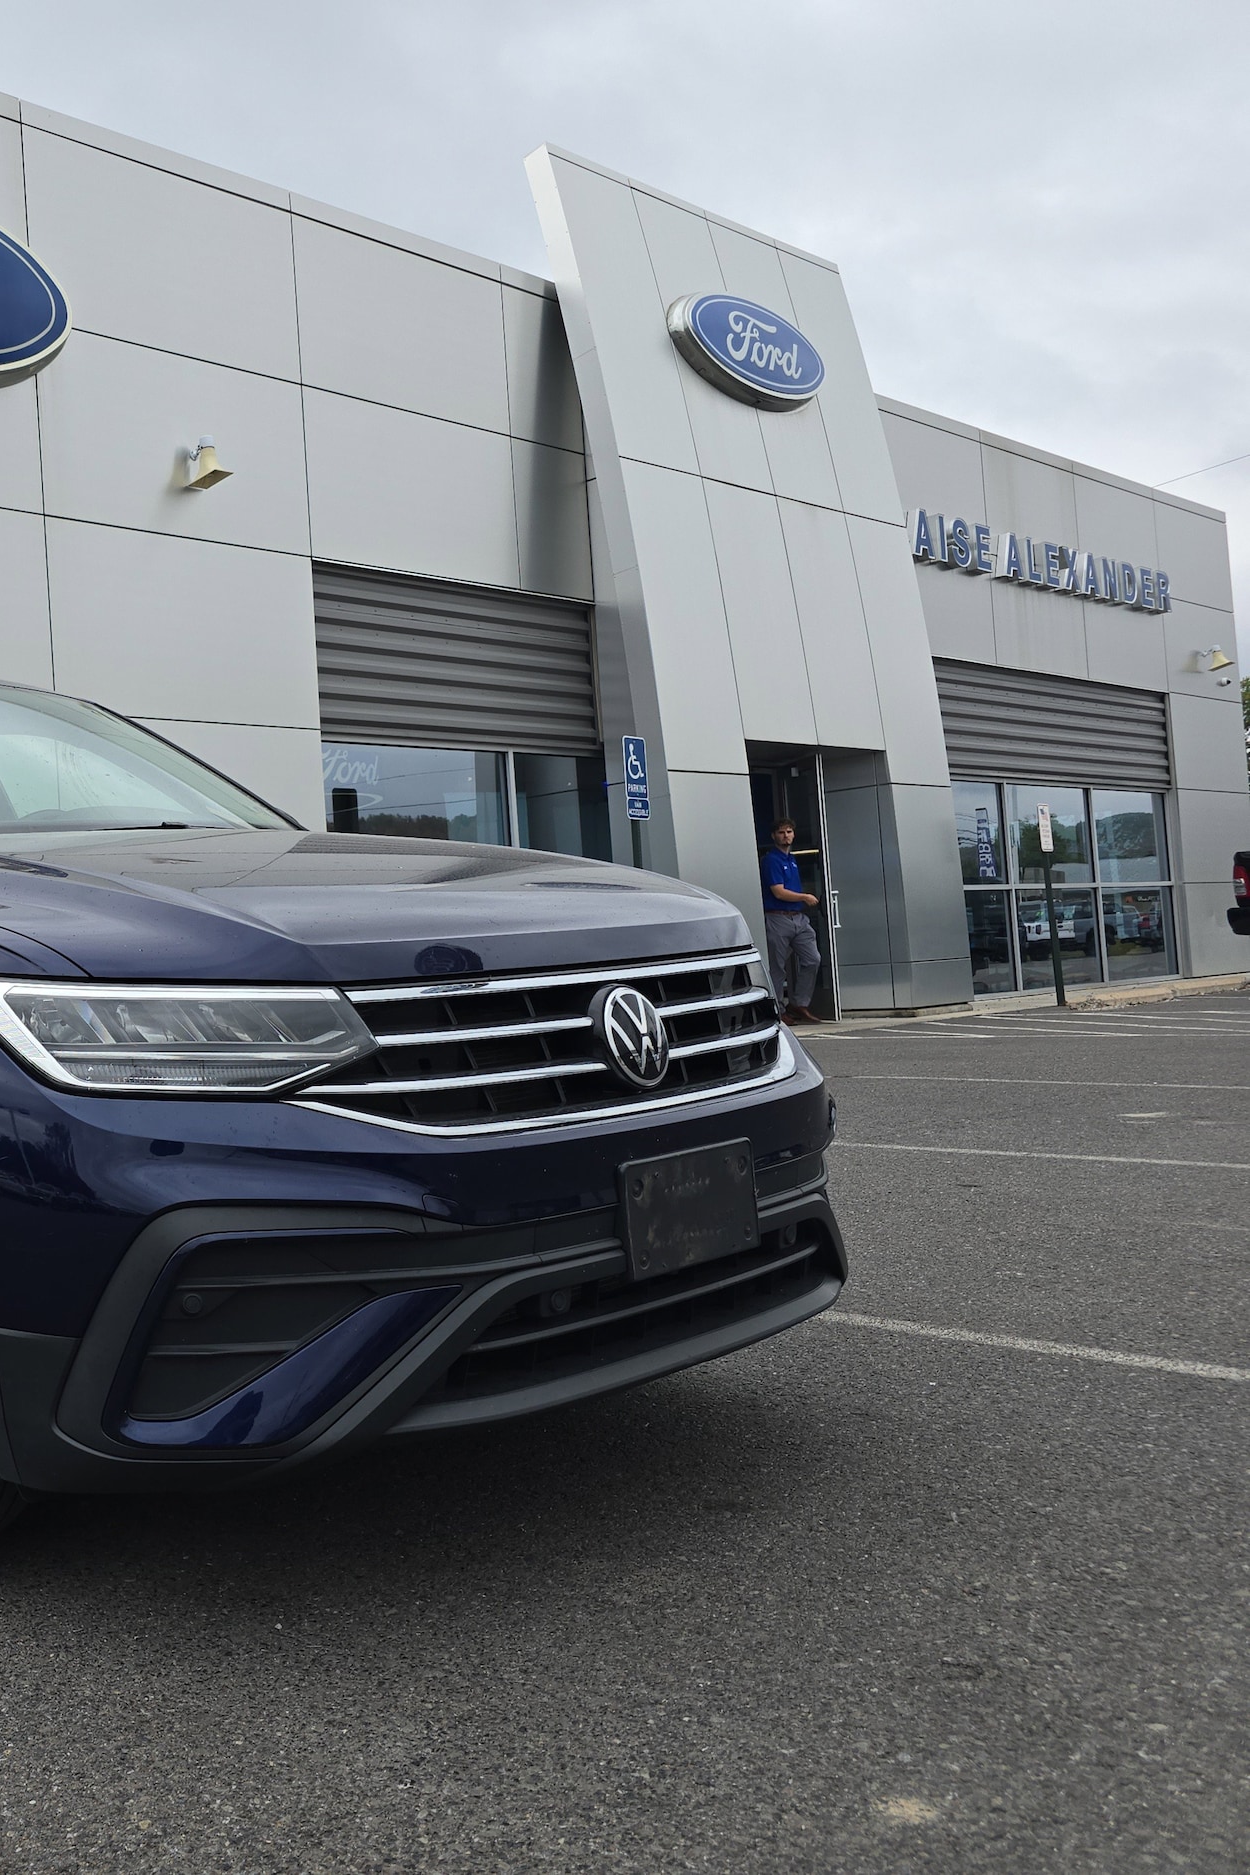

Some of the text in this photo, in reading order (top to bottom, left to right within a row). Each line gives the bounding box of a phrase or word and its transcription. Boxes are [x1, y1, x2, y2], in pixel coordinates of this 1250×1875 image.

[726, 310, 802, 380] Ford
[912, 508, 1172, 613] AISE ALEXANDER
